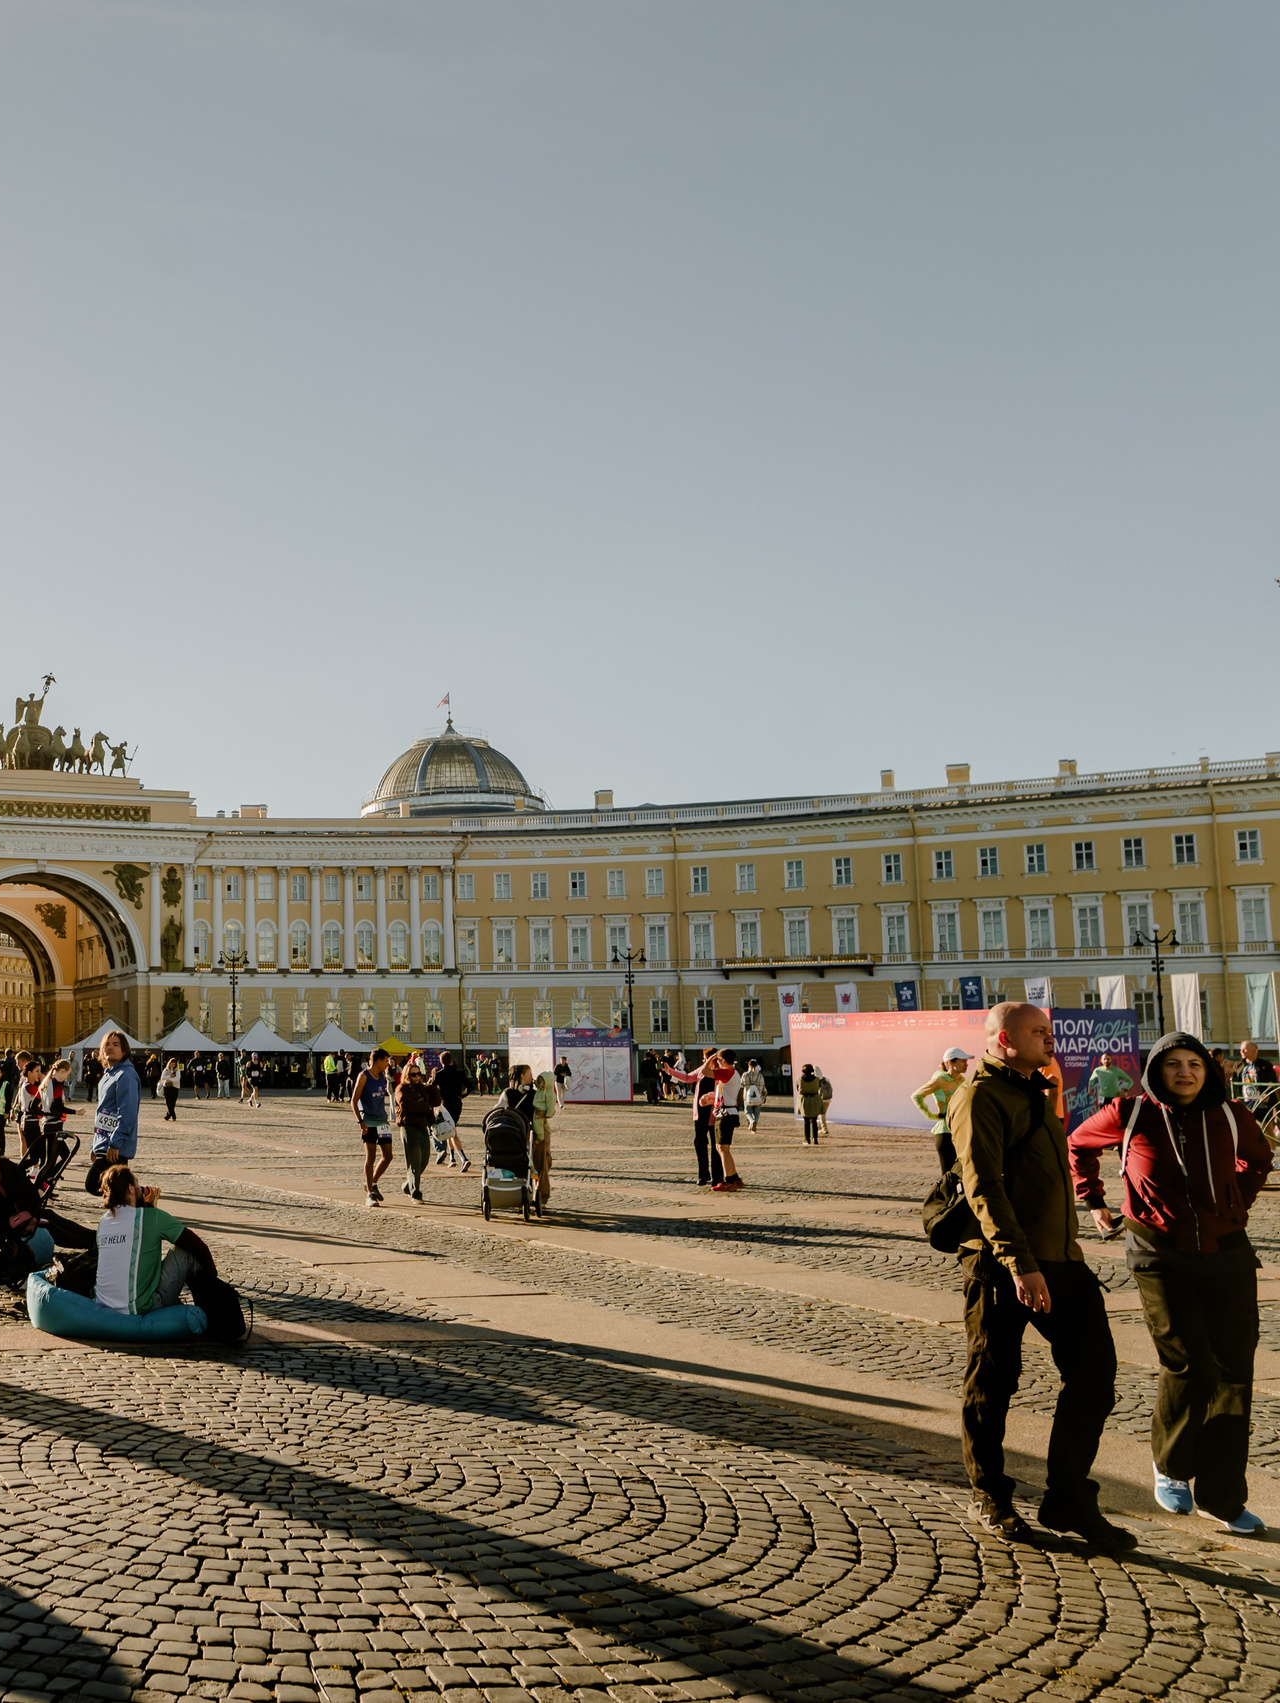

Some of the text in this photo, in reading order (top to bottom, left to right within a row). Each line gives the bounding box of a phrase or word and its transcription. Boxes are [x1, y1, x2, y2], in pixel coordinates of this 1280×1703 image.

[1052, 1019, 1135, 1041] ПОЛУ 2024
[1054, 1037, 1132, 1053] МАРАФОН
[98, 1116, 118, 1128] 4930
[108, 1234, 127, 1245] HELIX
